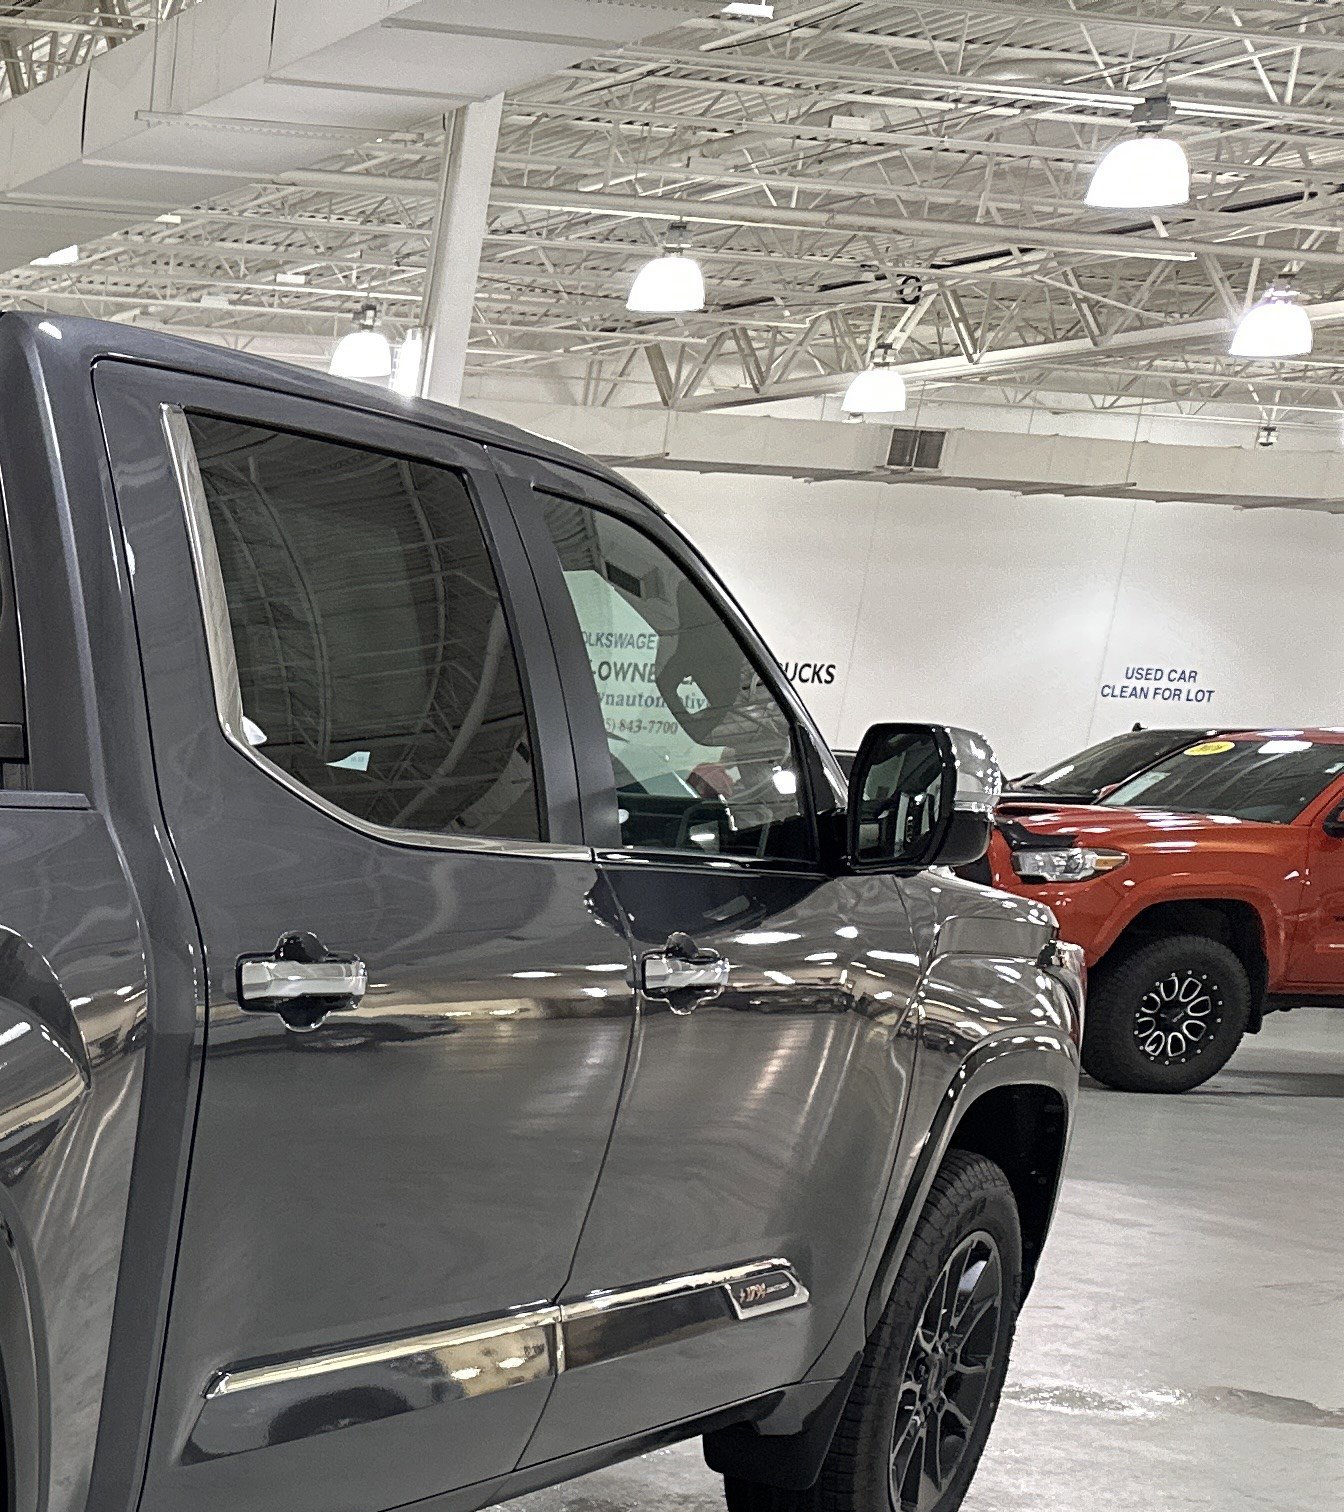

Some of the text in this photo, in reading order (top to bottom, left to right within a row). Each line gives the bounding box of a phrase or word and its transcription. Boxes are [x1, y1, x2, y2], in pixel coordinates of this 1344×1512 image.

[1125, 666, 1198, 683] USED CAR
[1100, 684, 1215, 702] CLEAN FOR LOT
